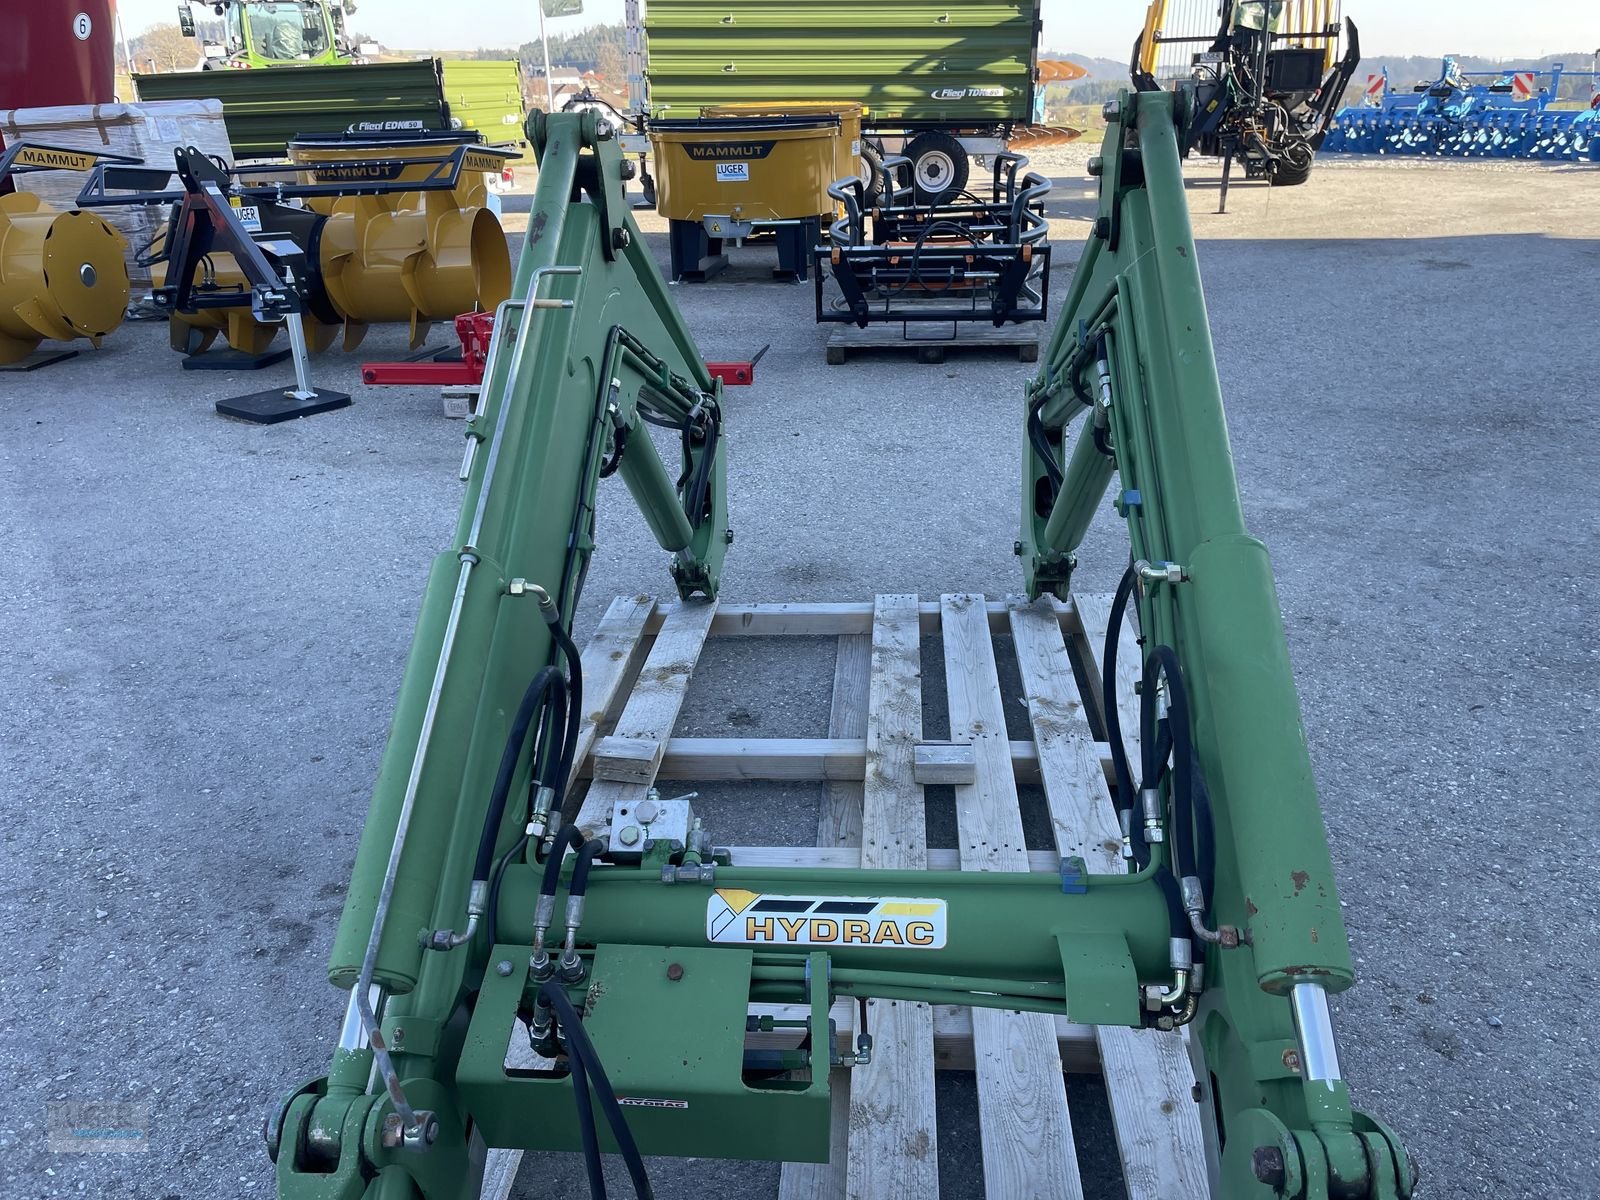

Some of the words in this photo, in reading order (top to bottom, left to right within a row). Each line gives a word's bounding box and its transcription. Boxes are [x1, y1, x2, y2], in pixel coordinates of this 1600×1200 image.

[80, 18, 86, 34] 6
[693, 146, 763, 157] MAMMUT
[23, 151, 87, 167] MAMMUT
[466, 155, 501, 169] MAMMUT
[314, 166, 392, 177] MAMMUT
[717, 164, 744, 174] LUGER
[236, 208, 256, 220] UGER
[746, 917, 934, 945] HYDRAC
